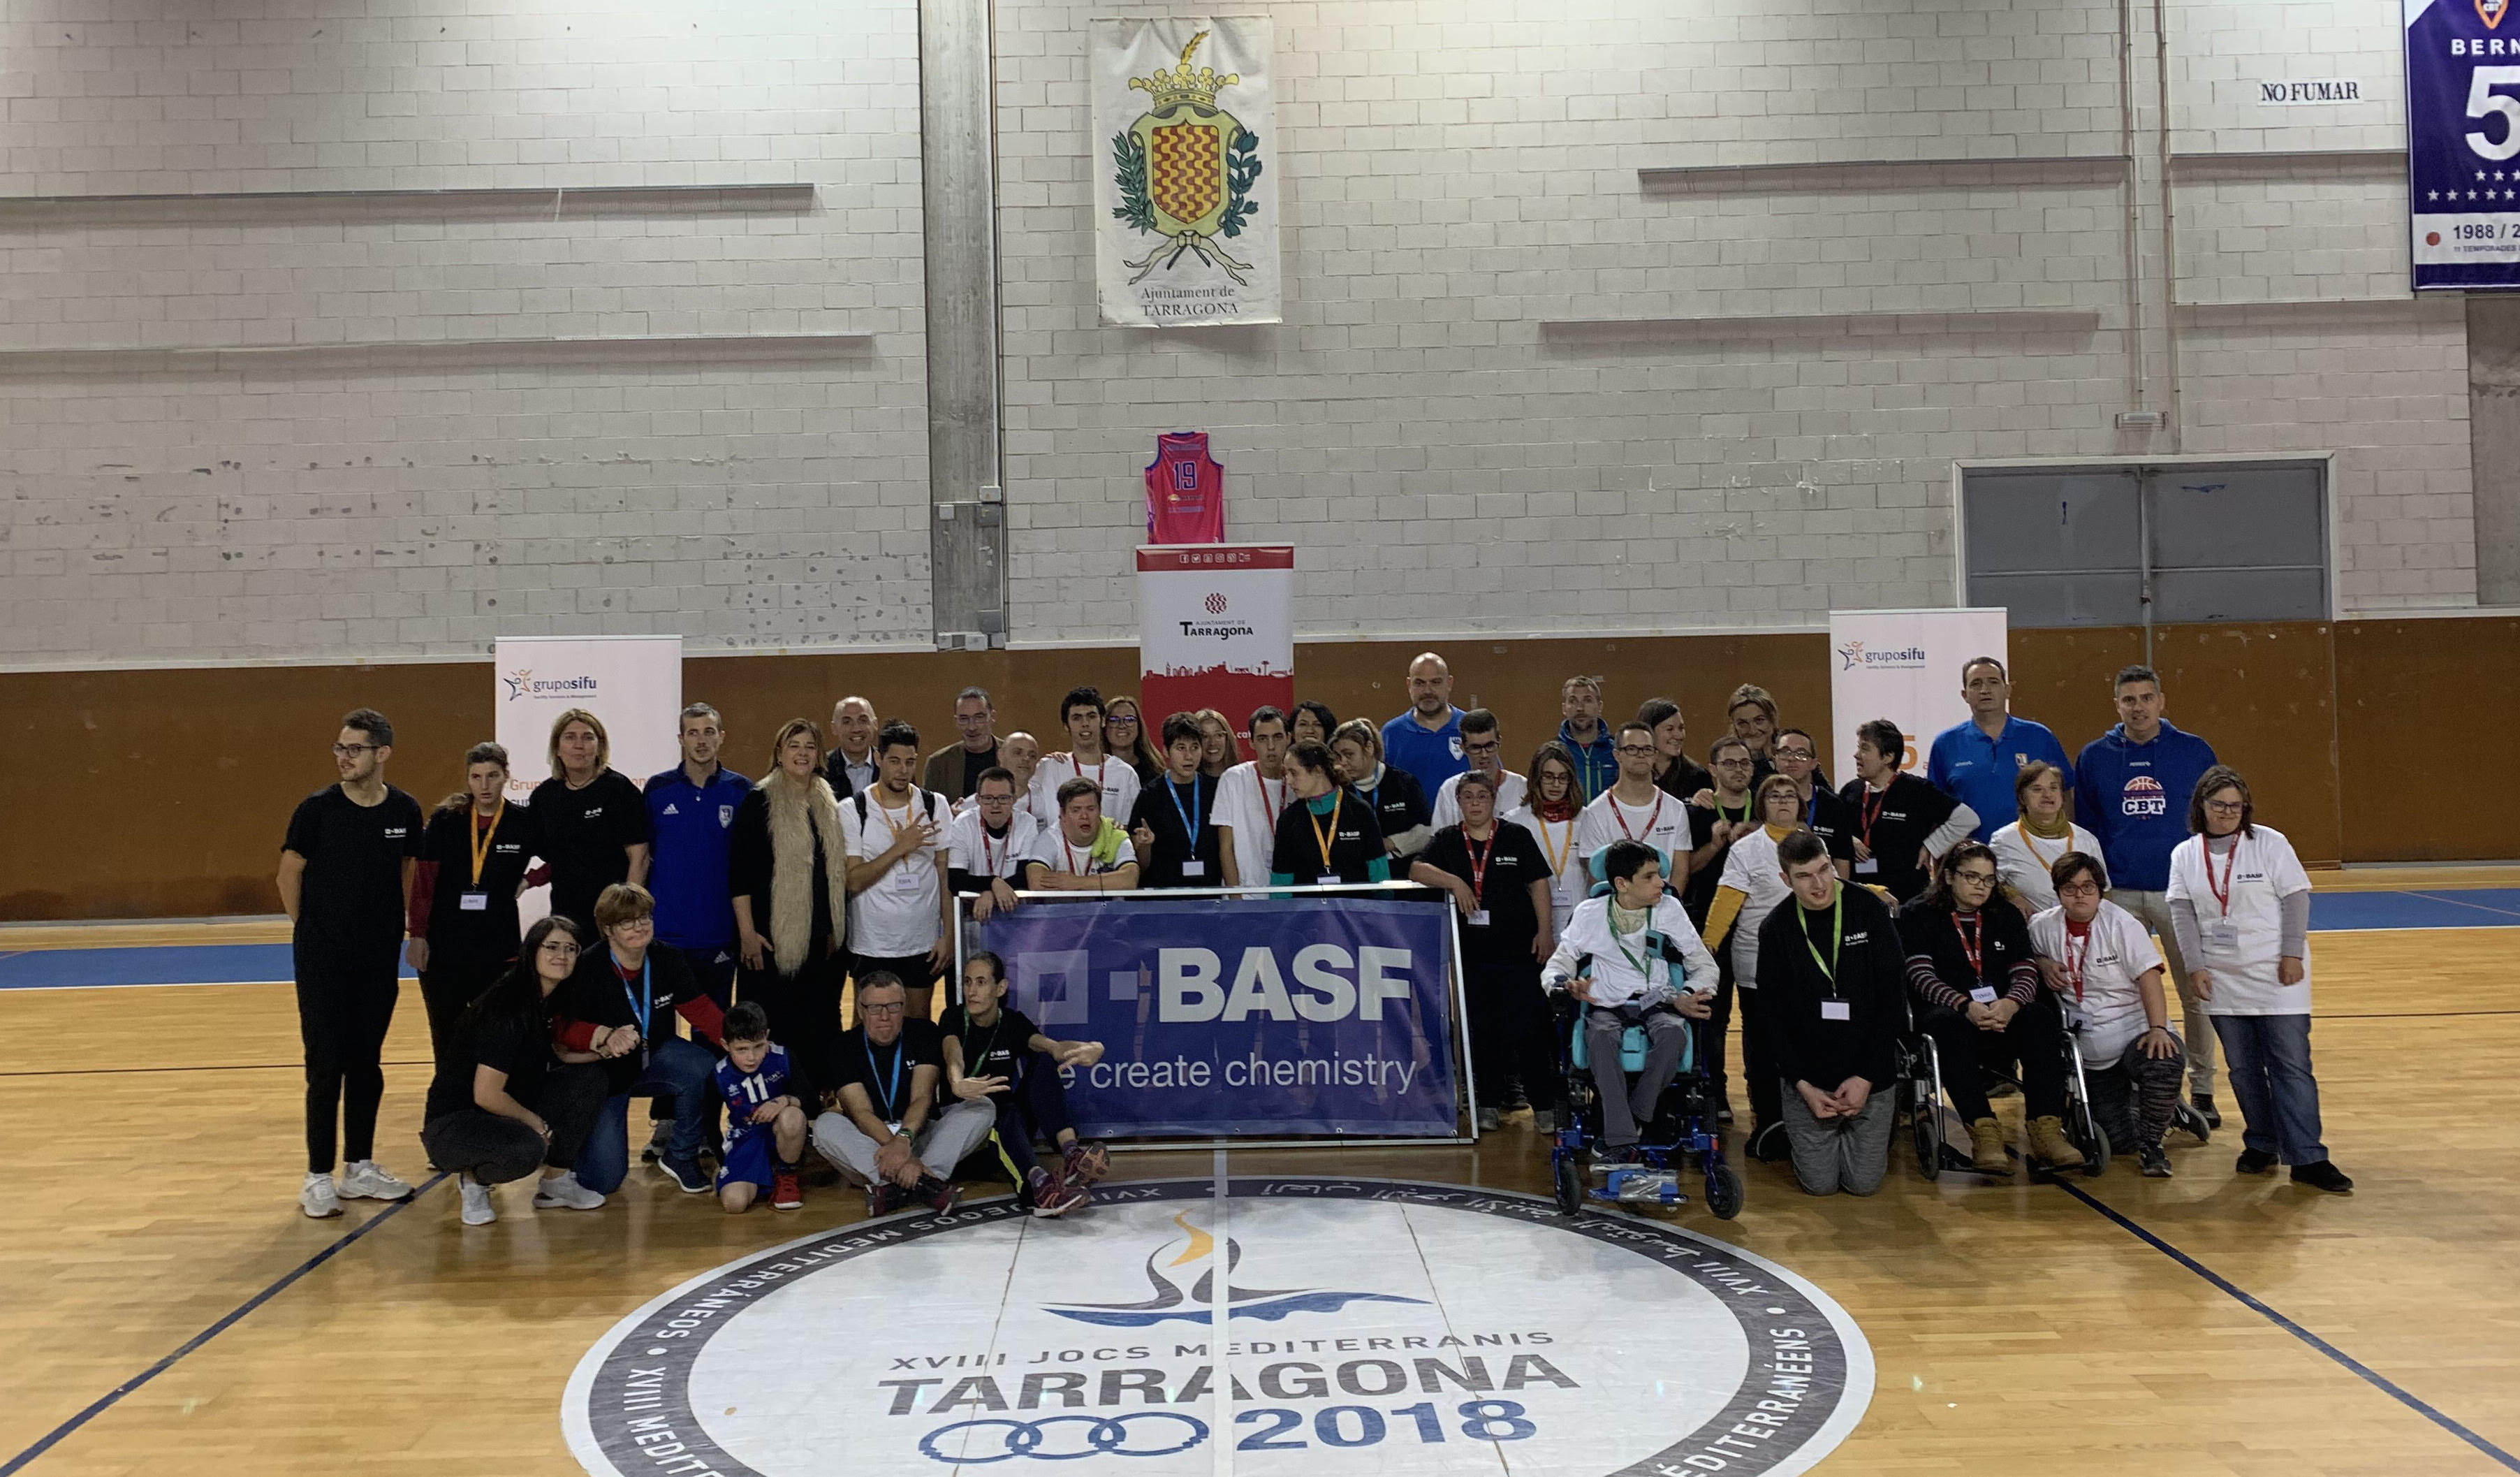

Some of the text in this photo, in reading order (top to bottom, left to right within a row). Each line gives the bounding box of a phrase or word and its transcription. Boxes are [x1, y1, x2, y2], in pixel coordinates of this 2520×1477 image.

[2262, 81, 2360, 101] NO FUMAR
[2453, 224, 2494, 239] 1988
[1141, 286, 1235, 303] Ajuntament de
[1141, 303, 1238, 316] TARRAGONA
[1173, 461, 1198, 490] 19
[1865, 648, 1926, 663] gruposifu
[533, 676, 597, 692] gruposifu
[2123, 799, 2165, 815] CBT
[1159, 943, 1412, 1023] BASF
[740, 1072, 770, 1104] 11
[1090, 1054, 1211, 1090] create
[1224, 1050, 1416, 1096] chemistry
[1692, 1262, 1769, 1296] XVIII
[888, 1332, 1555, 1370] XVIII JOCS MEDITERRANIS
[623, 1367, 666, 1411] XVIII
[877, 1353, 1581, 1416] TARRAGONA
[1647, 1328, 1813, 1477] ÉDITERRANÉENS
[1233, 1399, 1538, 1450] 2018
